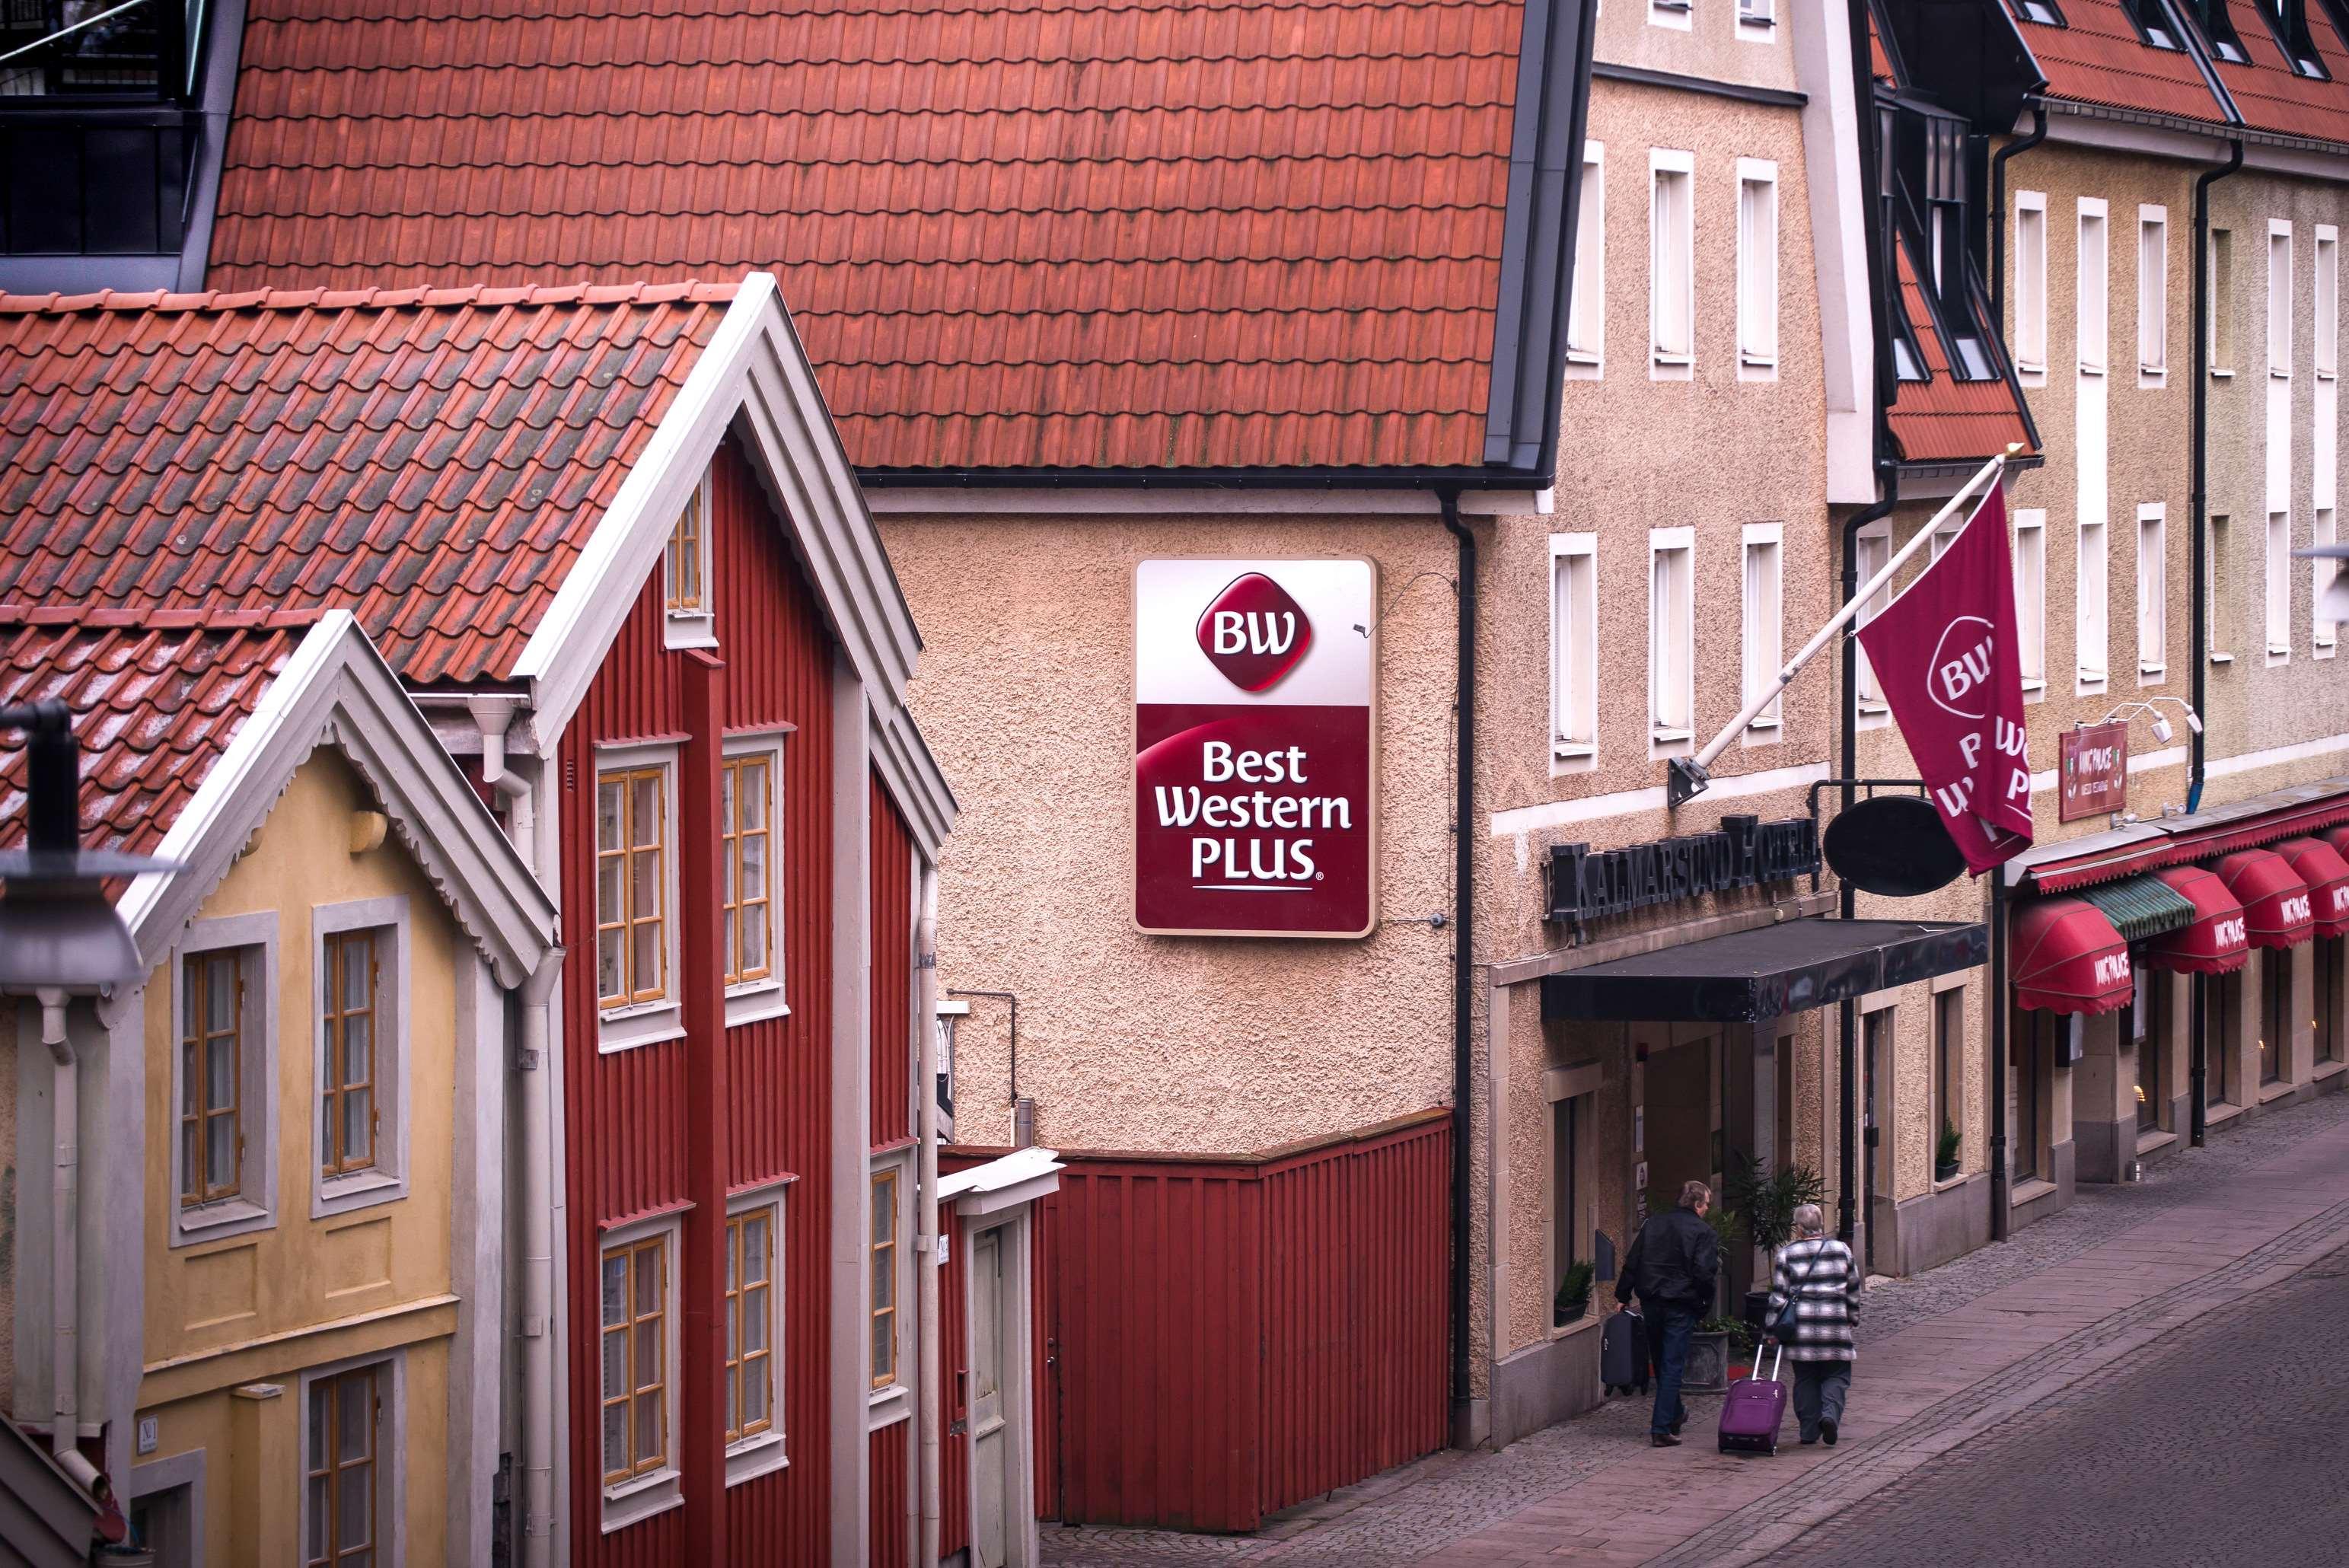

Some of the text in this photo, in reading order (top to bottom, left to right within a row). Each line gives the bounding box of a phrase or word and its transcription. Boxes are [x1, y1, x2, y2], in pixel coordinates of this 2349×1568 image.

[1214, 610, 1296, 655] BW
[1203, 741, 1308, 783] Best
[1155, 786, 1353, 829] Western
[1192, 837, 1315, 880] PLUS
[1560, 830, 1735, 921] KALMARSUND
